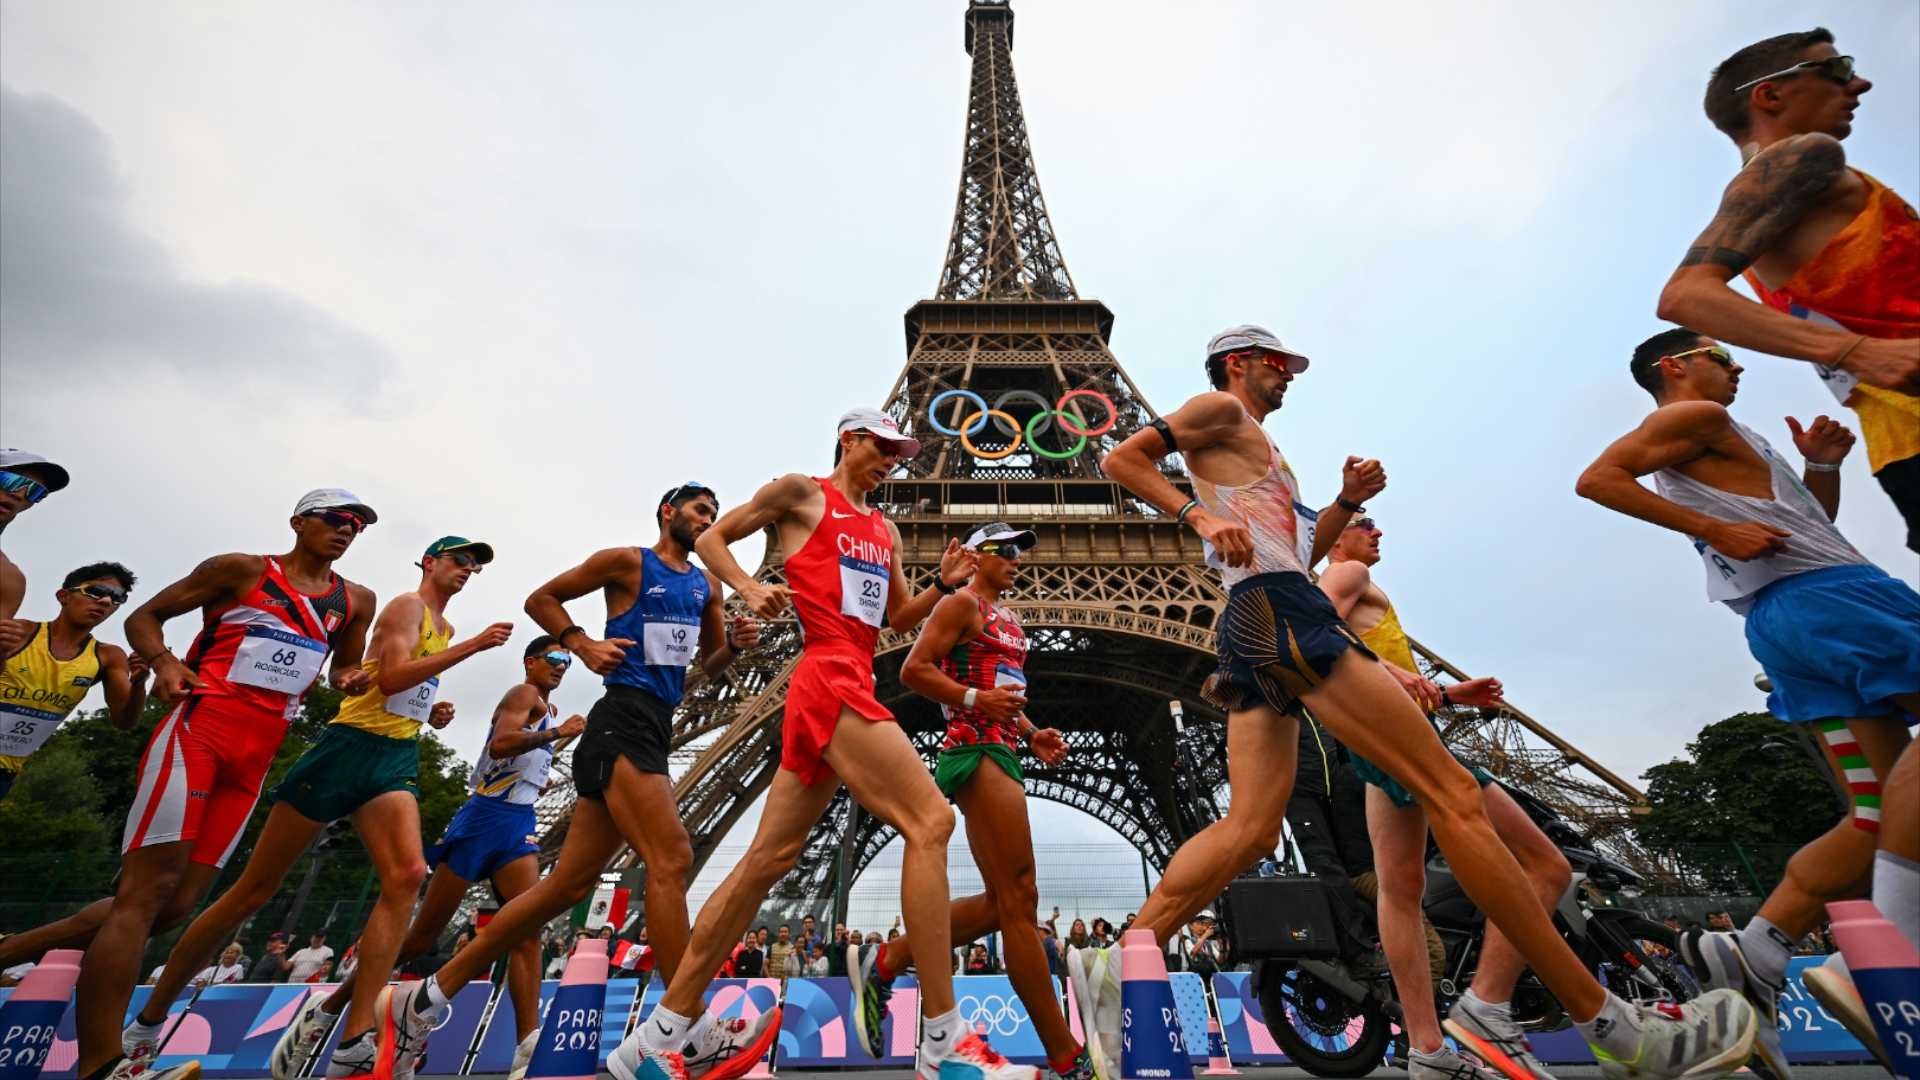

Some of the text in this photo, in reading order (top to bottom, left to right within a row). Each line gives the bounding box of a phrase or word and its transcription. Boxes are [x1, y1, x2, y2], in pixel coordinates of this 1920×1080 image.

[837, 533, 891, 568] CHINA
[862, 579, 881, 599] 23
[273, 631, 313, 647] PARIS 2024
[671, 628, 686, 643] 49
[271, 648, 297, 666] 68
[254, 661, 301, 679] RODRIGUEZ
[417, 686, 430, 700] 10
[9, 721, 38, 736] 25
